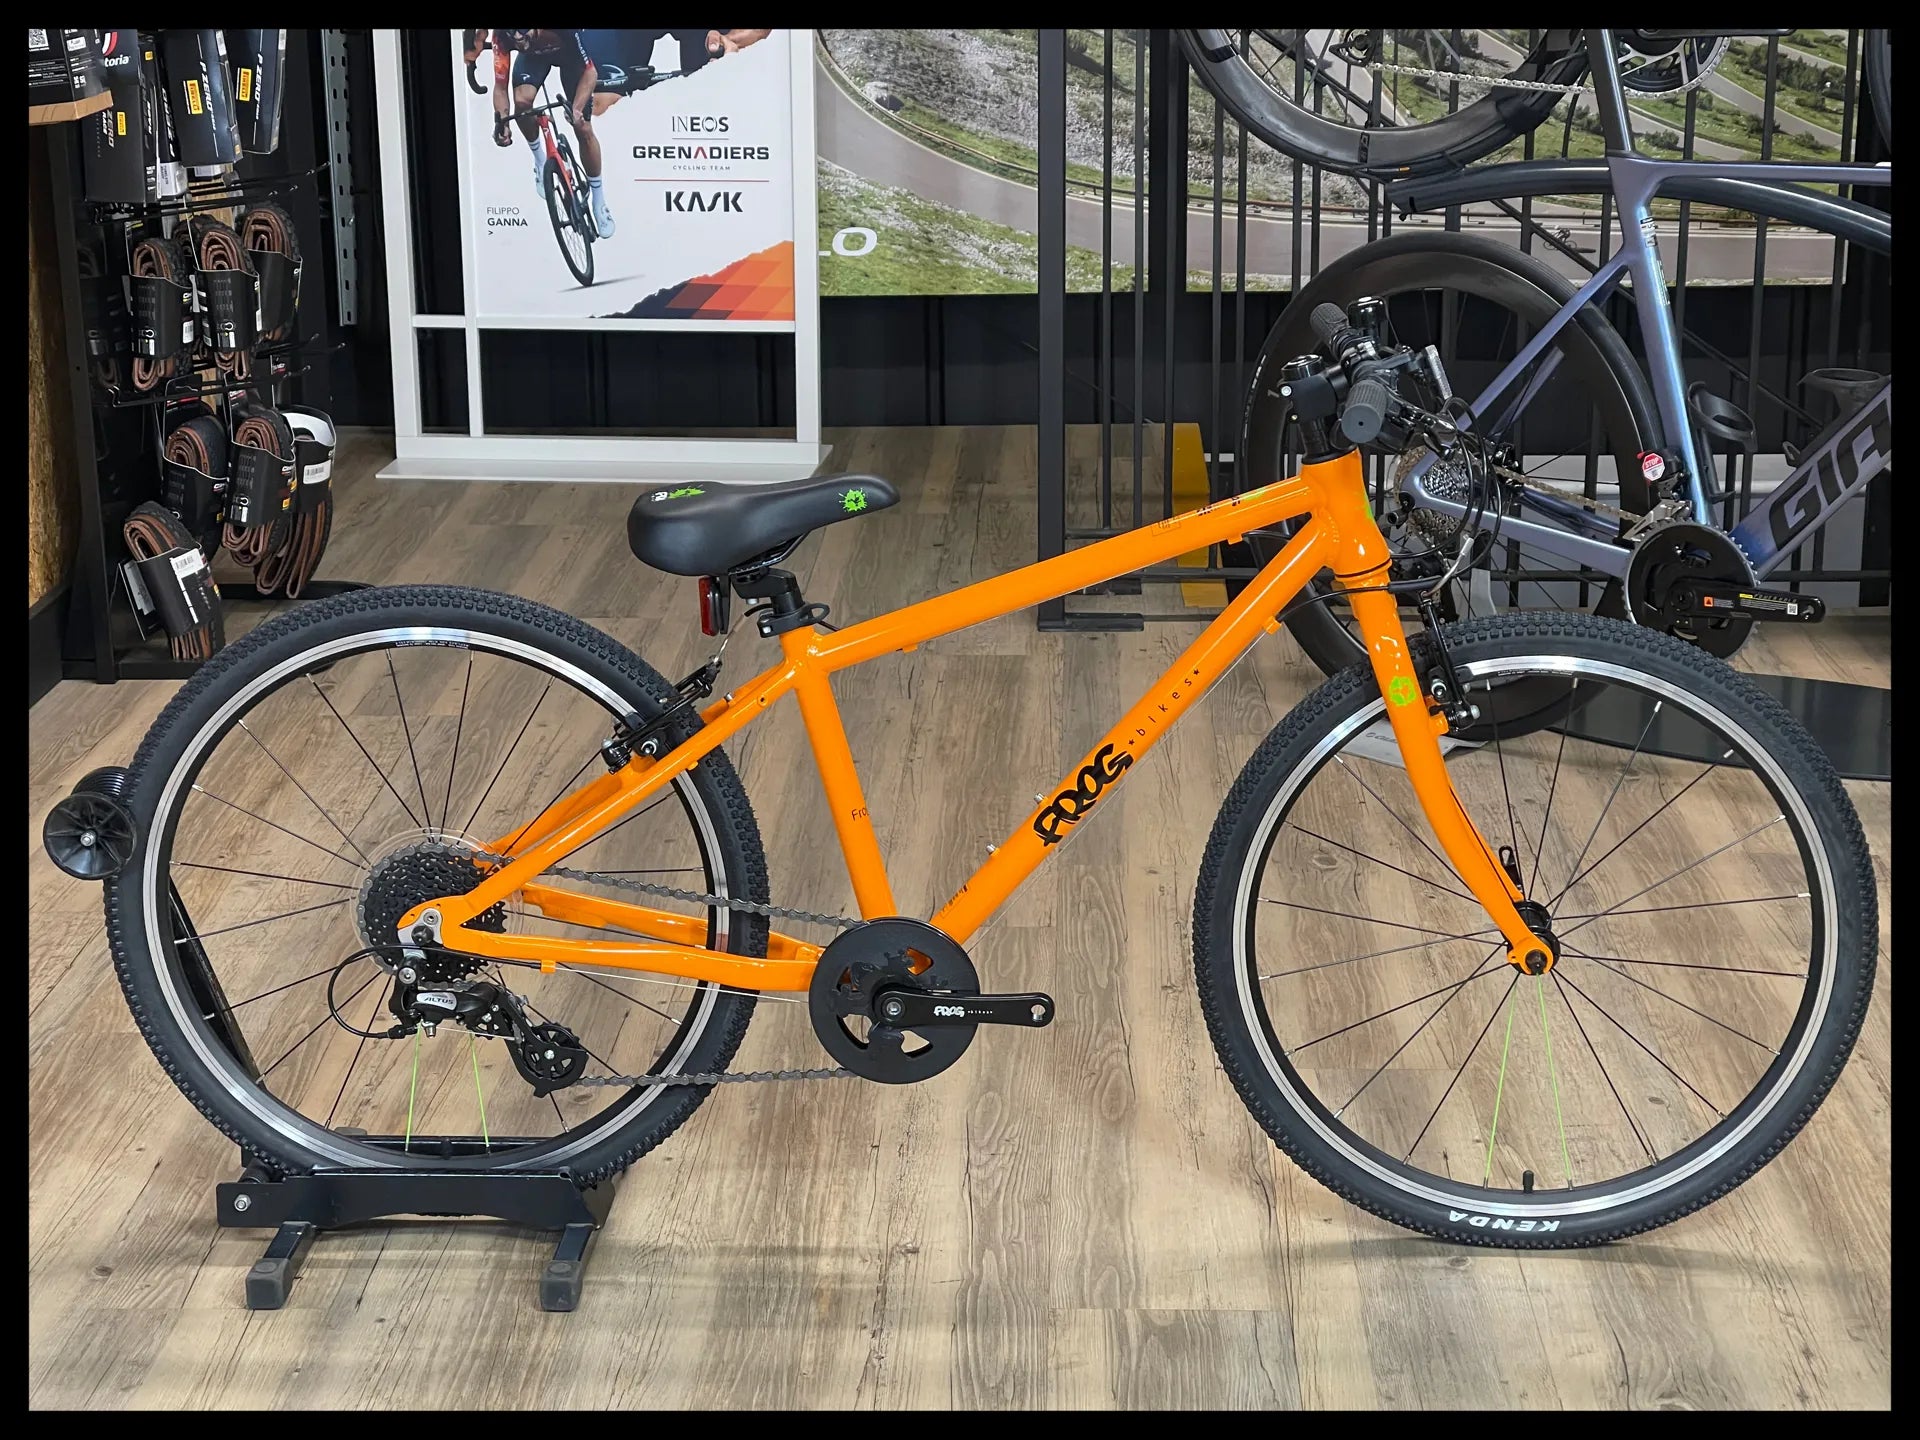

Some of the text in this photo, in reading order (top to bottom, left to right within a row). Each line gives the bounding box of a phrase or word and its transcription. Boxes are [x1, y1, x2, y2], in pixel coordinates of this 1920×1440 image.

[104, 55, 129, 67] toria
[189, 83, 200, 111] PIRELLI
[202, 73, 212, 112] ZERO
[672, 116, 729, 132] INEOS
[633, 146, 770, 160] GRENADIERS
[665, 191, 743, 212] KASK
[487, 207, 520, 215] FILIPPO
[487, 218, 528, 226] GANNA
[1033, 743, 1134, 847] FROG
[851, 807, 869, 821] Fro
[424, 997, 453, 1005] ALTUS
[934, 1006, 965, 1017] FROG
[1448, 1210, 1560, 1232] KENDA
